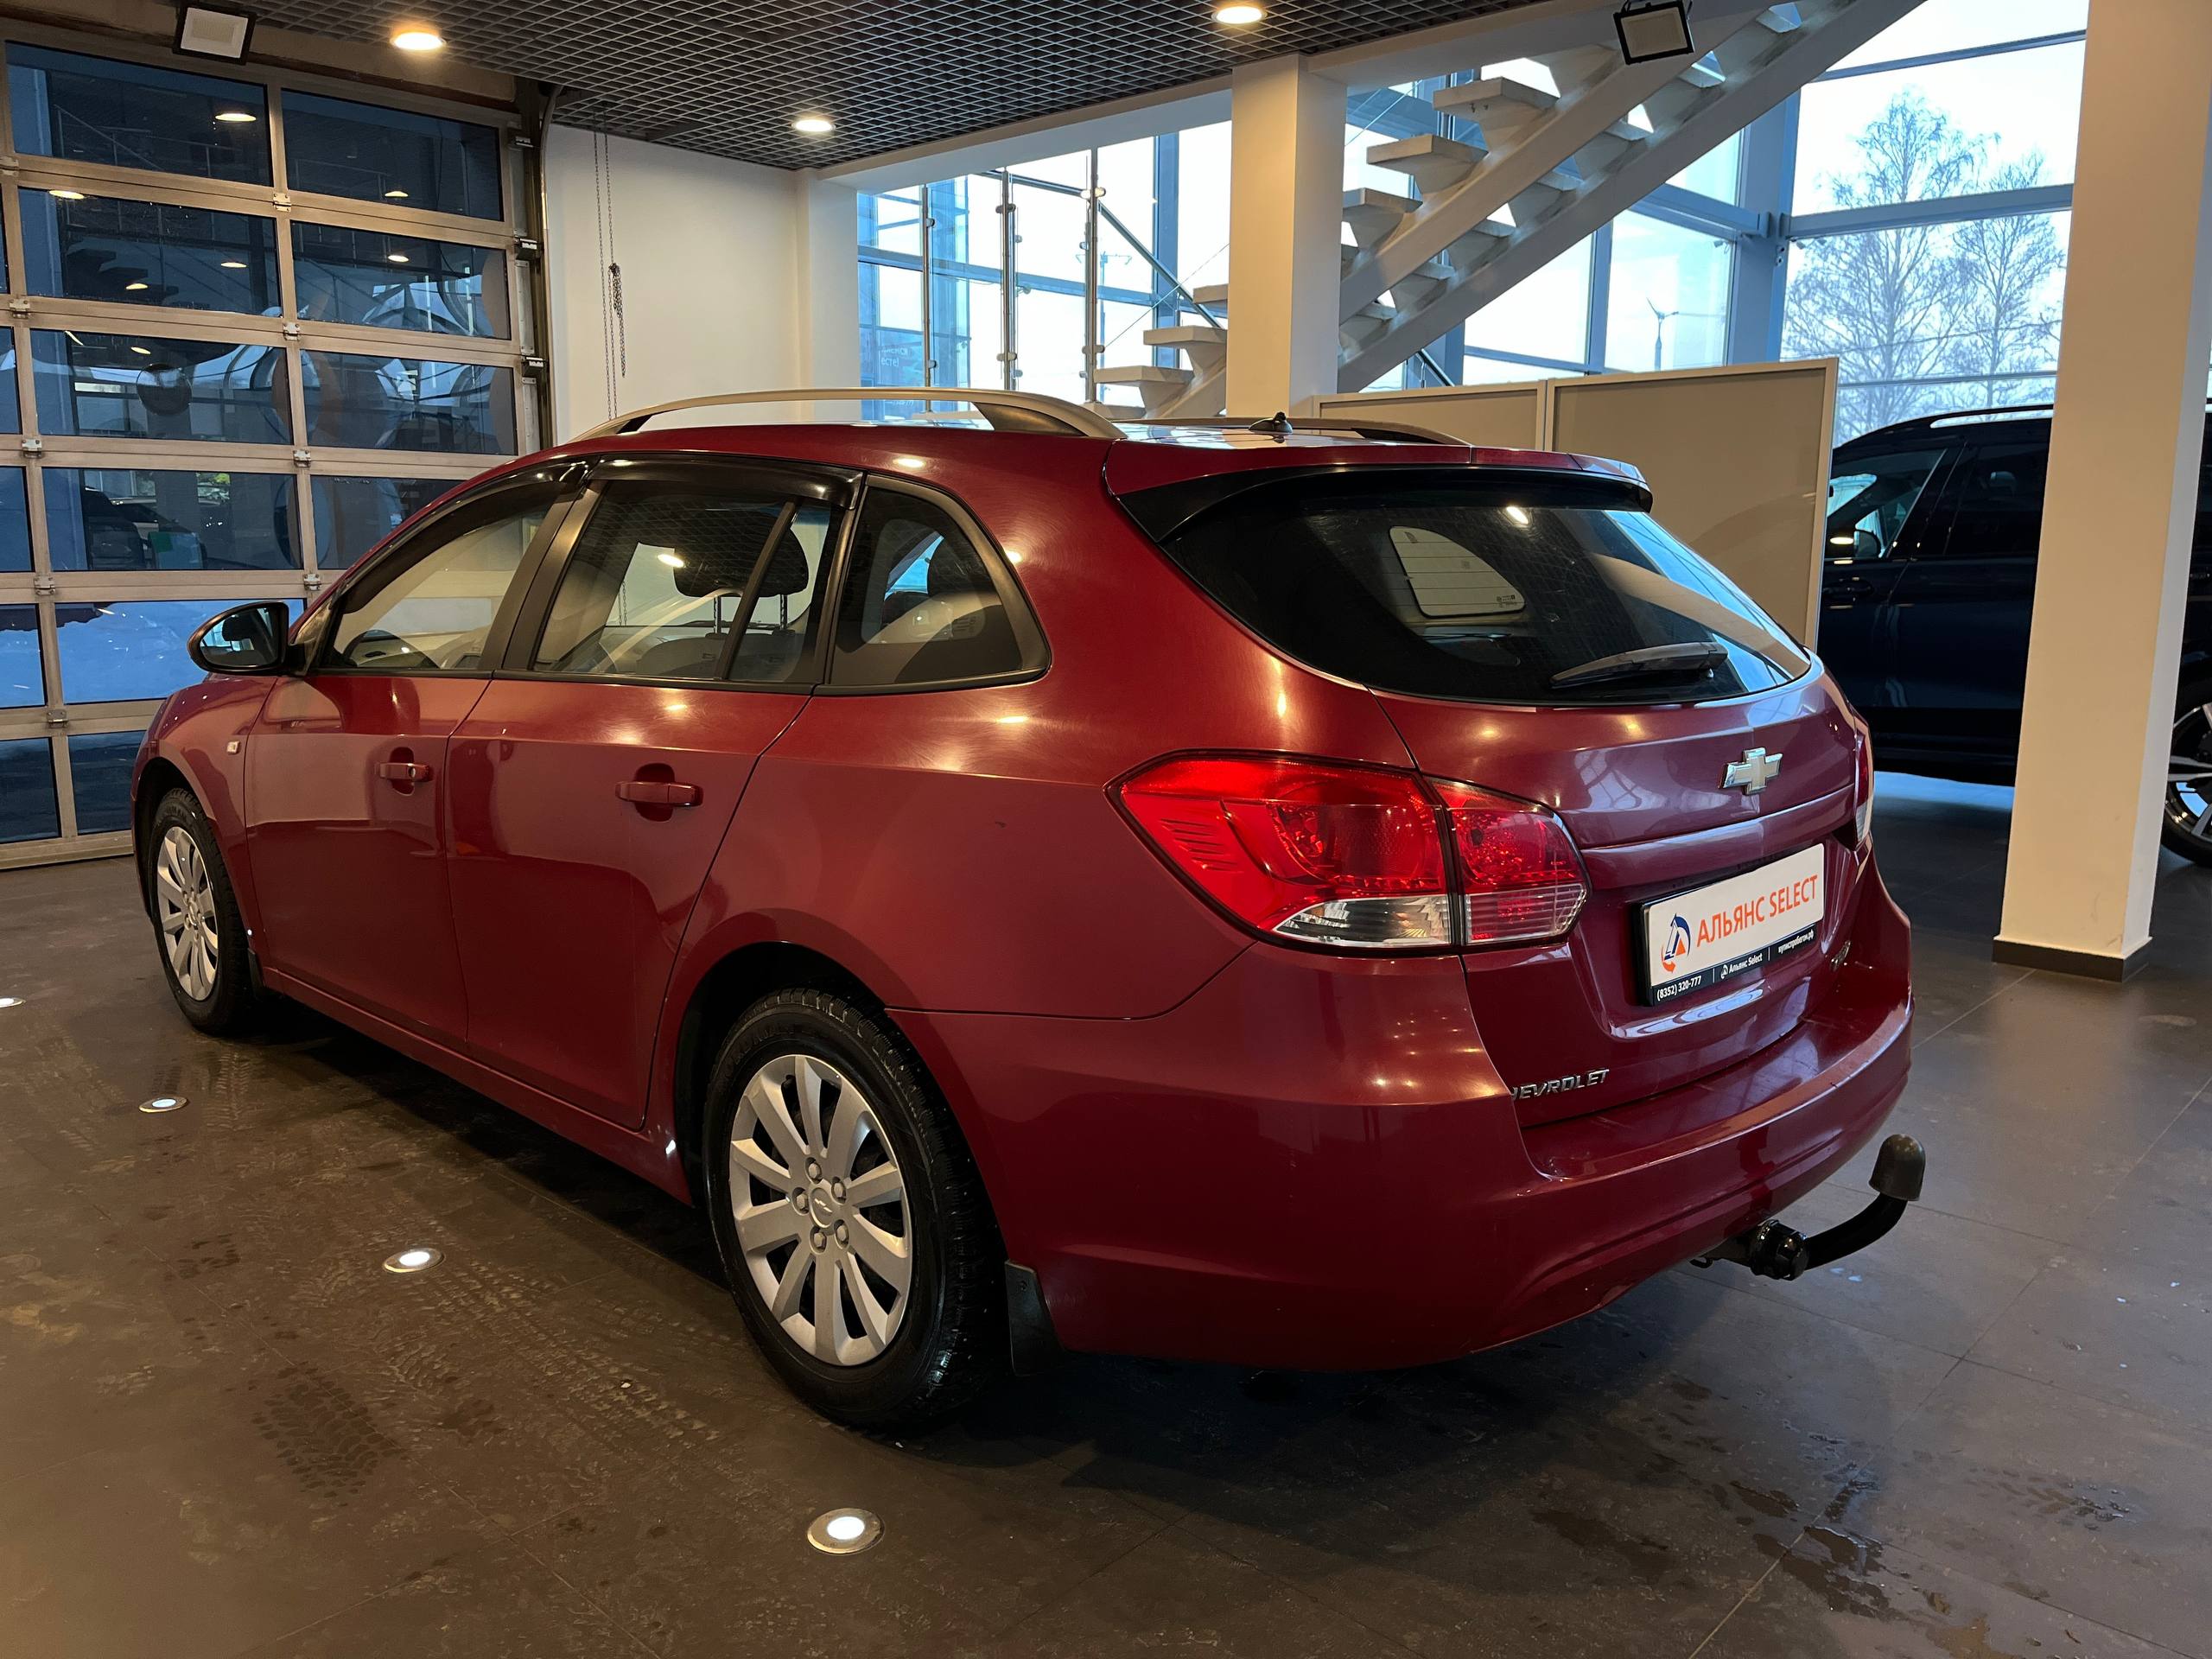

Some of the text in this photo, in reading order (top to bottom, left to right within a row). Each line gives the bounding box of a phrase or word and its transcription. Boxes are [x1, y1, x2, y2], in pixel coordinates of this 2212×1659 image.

[1696, 874, 1818, 947] АЛЬЯНС SELECT
[1657, 985, 1677, 1001] (8352)
[1678, 976, 1701, 991] 320-777
[1729, 960, 1748, 974] Альянс
[1748, 953, 1763, 966] Select
[1512, 1069, 1610, 1100] HEVROLET
